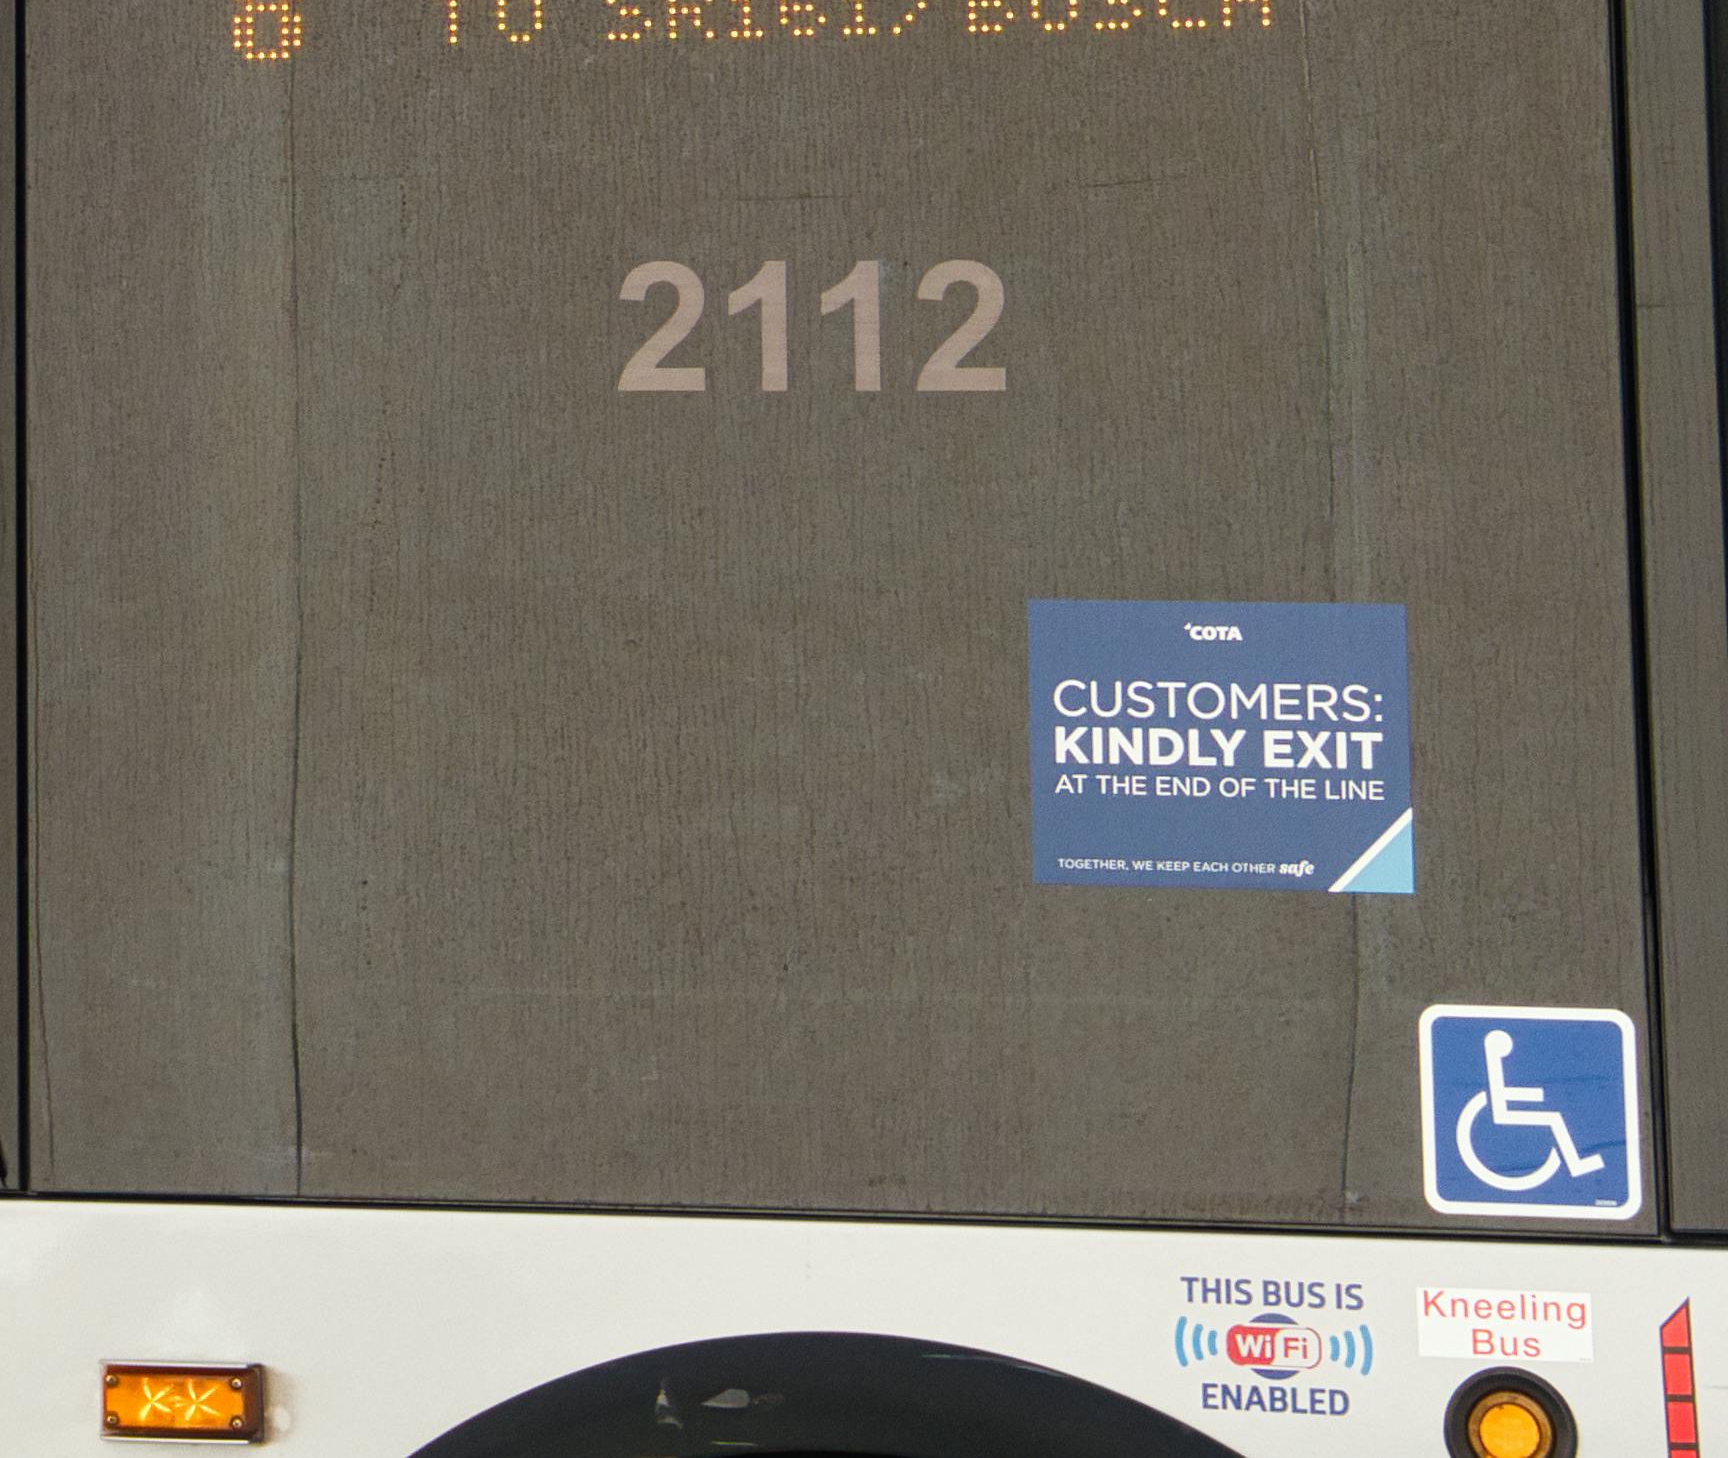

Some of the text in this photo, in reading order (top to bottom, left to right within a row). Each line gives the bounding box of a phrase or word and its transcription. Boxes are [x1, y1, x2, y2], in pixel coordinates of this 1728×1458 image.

[618, 260, 1005, 391] 2112
[1189, 626, 1243, 641] COTA
[1054, 680, 1382, 721] CUSTOMERS:
[1055, 726, 1382, 769] KINDLY EXIT
[1055, 774, 1384, 800] AT THE END OF THE LINE
[1132, 860, 1153, 871] WE
[1156, 861, 1190, 871] KEEP
[1193, 862, 1228, 872] EACH
[1231, 862, 1275, 874] OTHER
[1279, 860, 1315, 877] safe
[1180, 1276, 1363, 1310] THIS BUS IS
[1423, 1289, 1586, 1329] Kneeling
[1471, 1328, 1541, 1357] Bus
[1201, 1382, 1350, 1416] ENABLED
